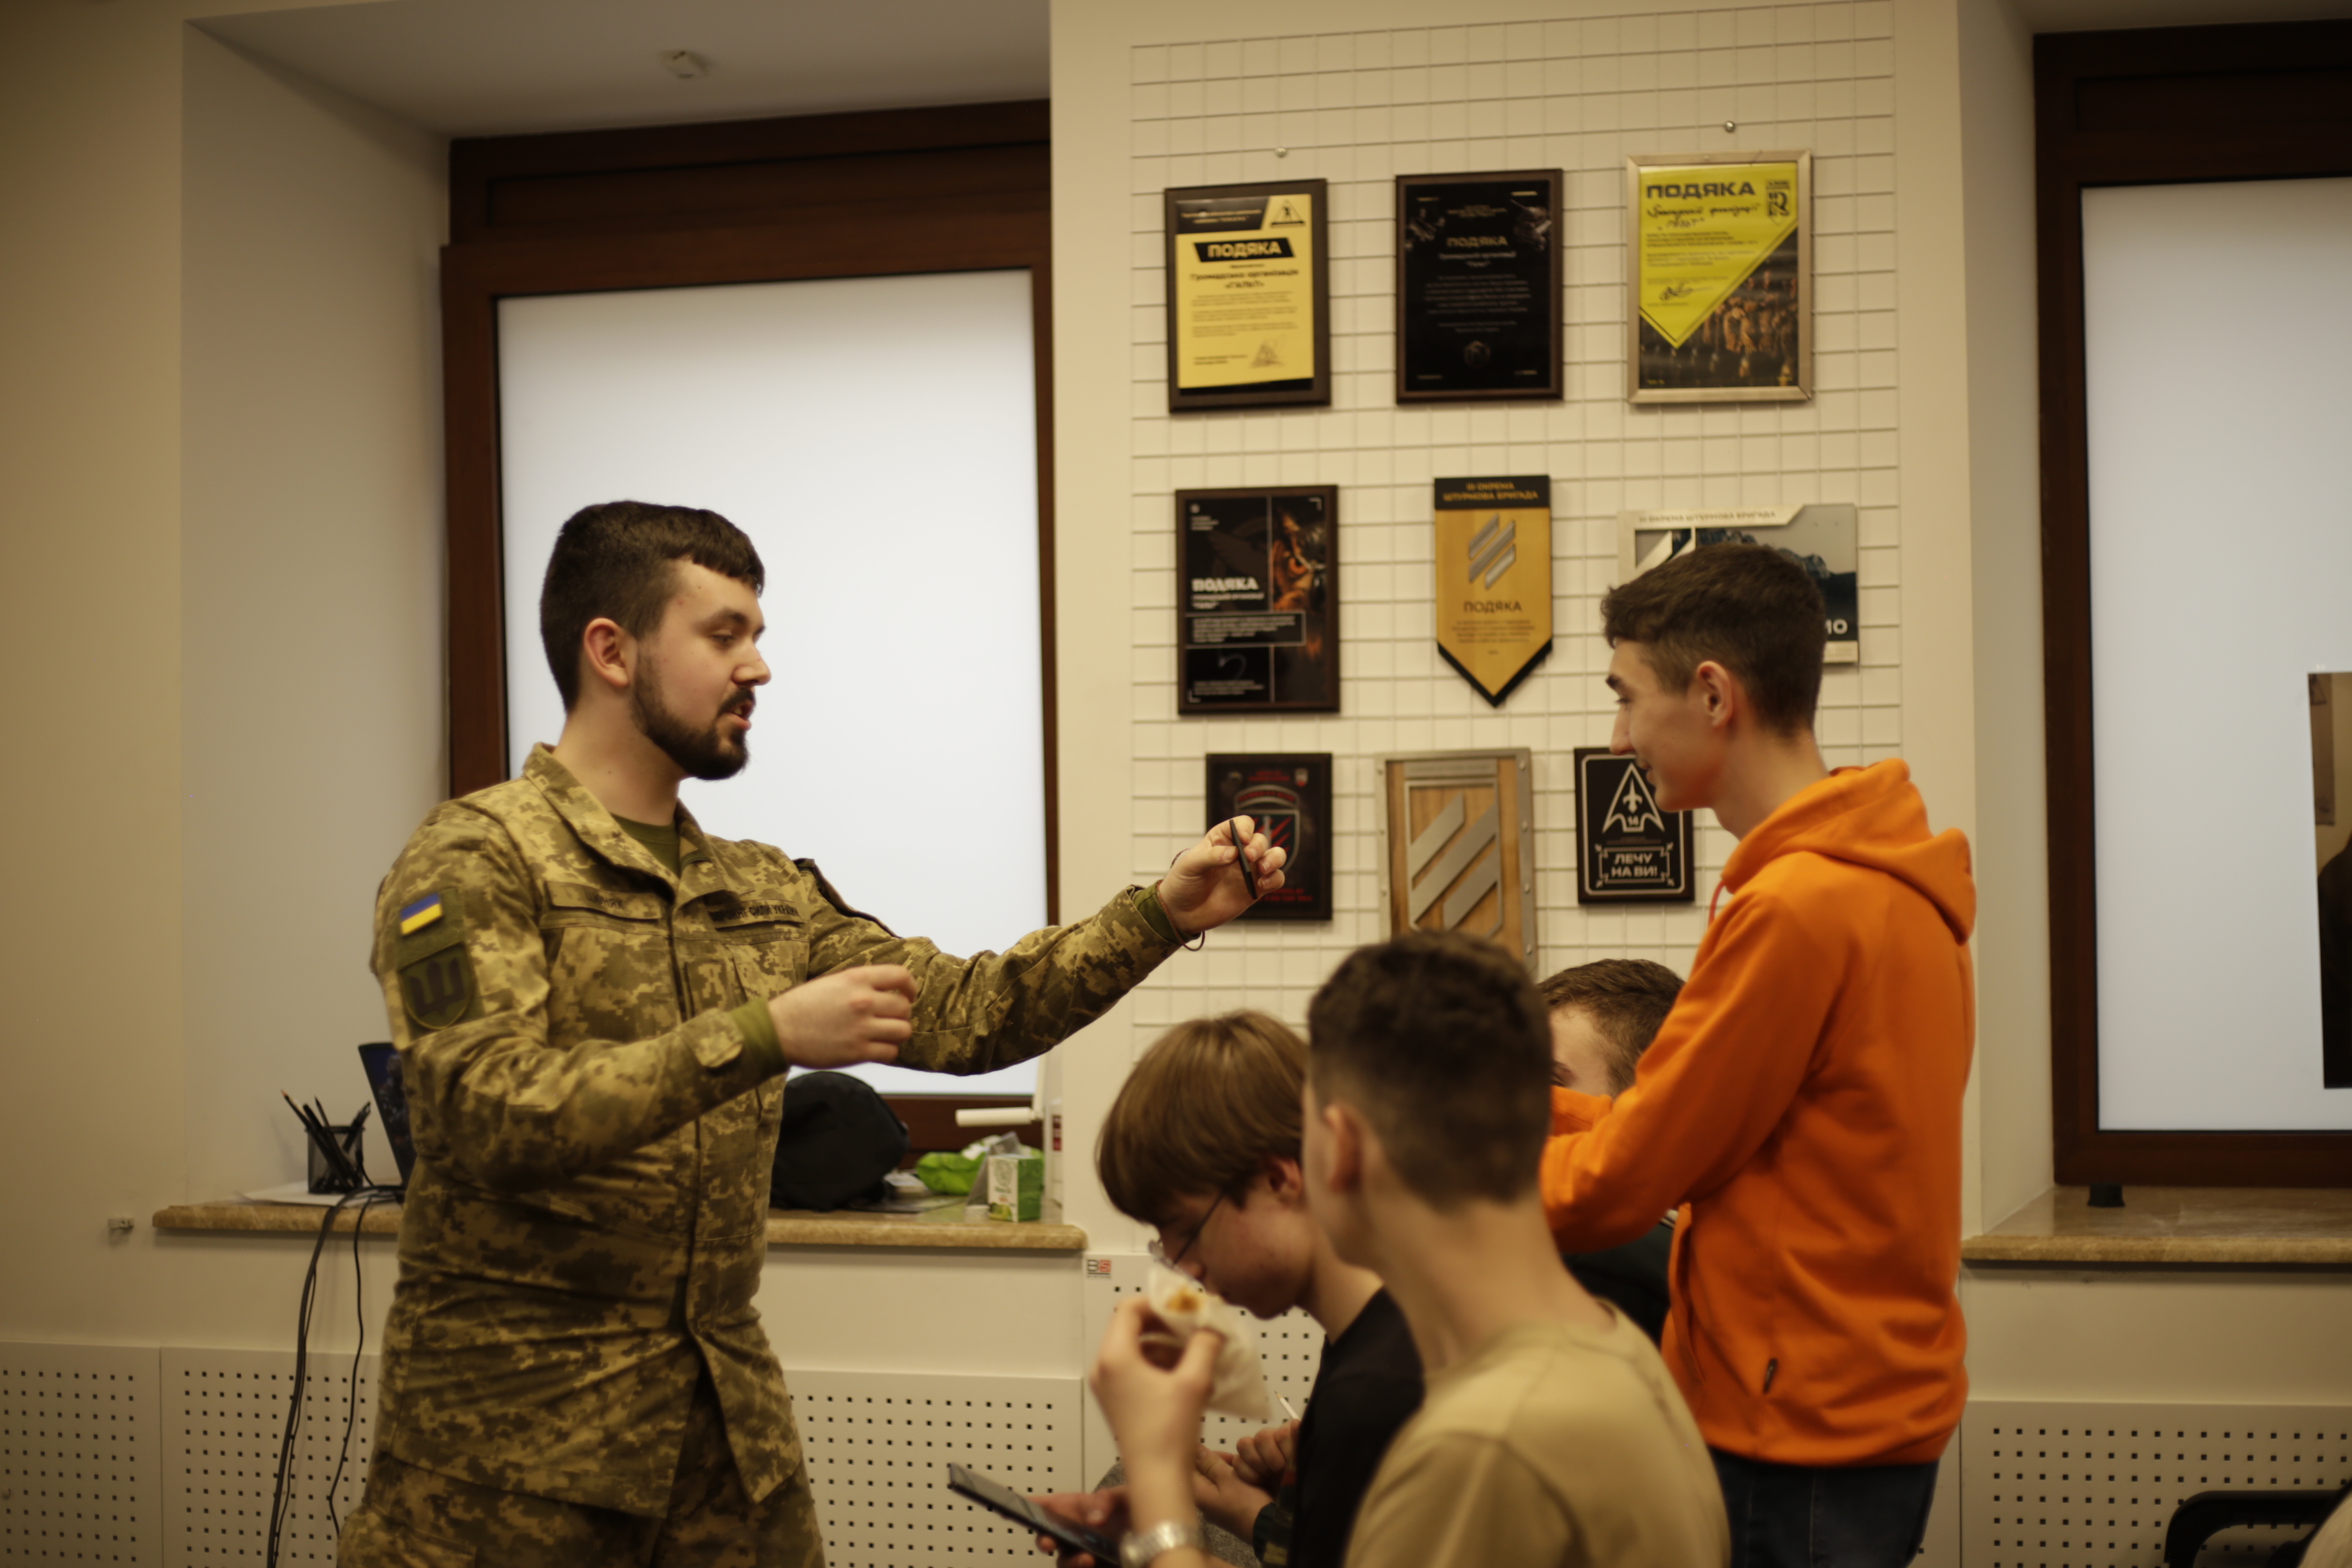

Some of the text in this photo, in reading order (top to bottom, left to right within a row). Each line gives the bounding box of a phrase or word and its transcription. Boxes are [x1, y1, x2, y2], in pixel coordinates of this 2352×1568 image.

[1647, 182, 1756, 199] ПОДЯКА
[1446, 236, 1509, 248] ПОДЯКА
[1208, 241, 1282, 258] ПОДЯКА
[1477, 482, 1515, 491] ОКРЕМА
[1443, 491, 1539, 501] ШТУРМОВА БРИГАДА
[1192, 577, 1259, 592] ПОДЯКА
[1464, 600, 1522, 614] ПОДЯКА
[1614, 853, 1652, 865] ЛЕЧУ
[1611, 866, 1658, 877] НА ВИ!
